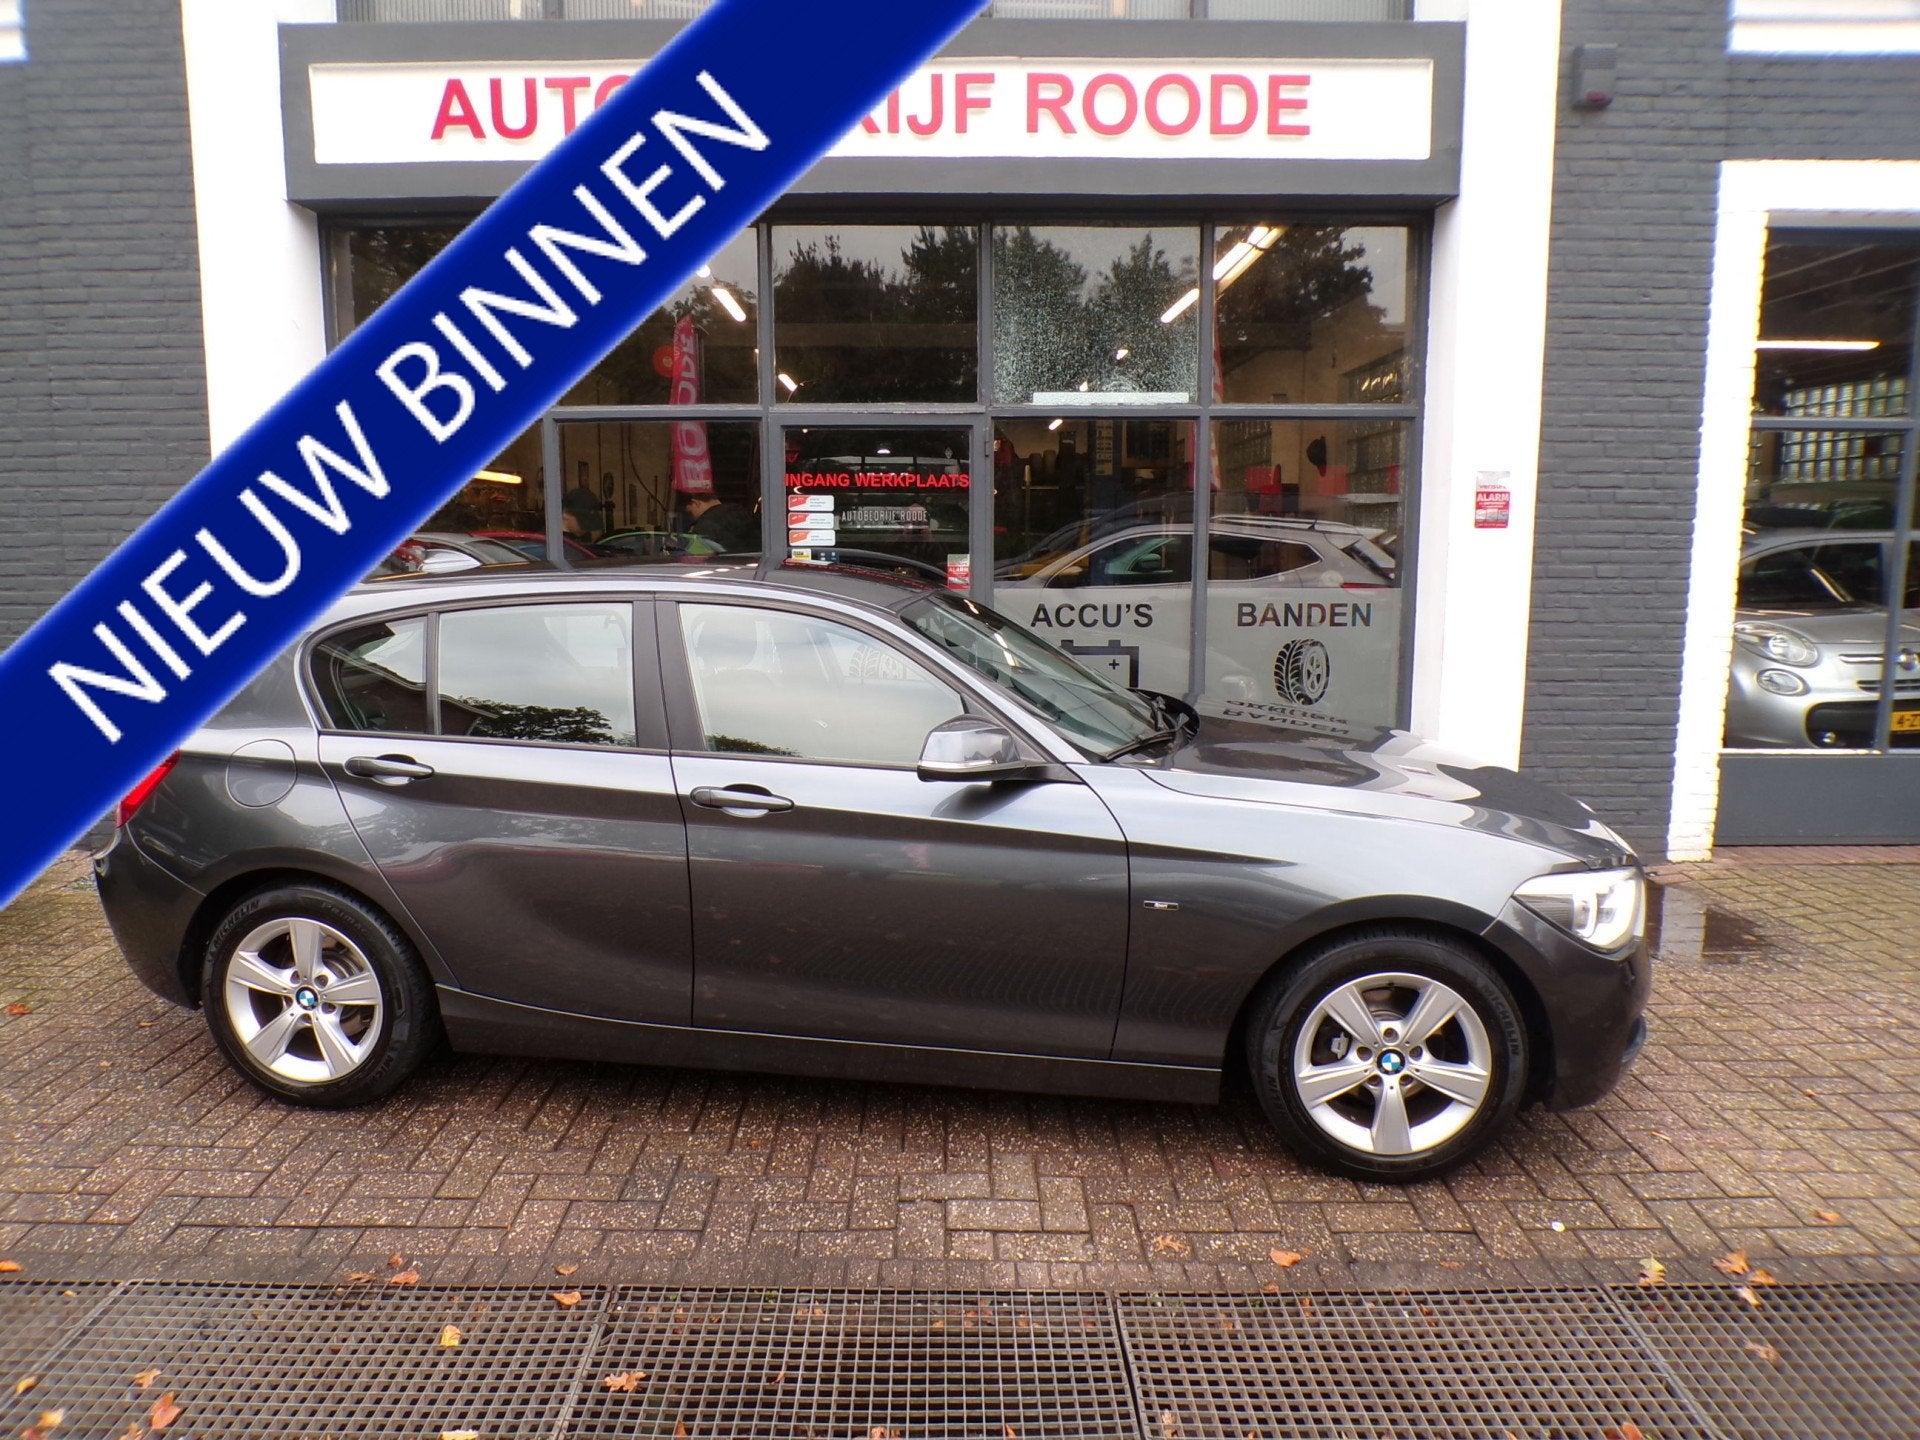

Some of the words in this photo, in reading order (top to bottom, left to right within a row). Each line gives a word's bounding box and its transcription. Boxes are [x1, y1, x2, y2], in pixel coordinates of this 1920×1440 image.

[1027, 73, 1311, 135] ROODE
[784, 473, 850, 487] INGANG
[855, 473, 970, 487] WERKPLAATS
[1477, 492, 1510, 502] ALARM
[1031, 603, 1153, 628] ACCU'S
[1237, 603, 1372, 628] BANDEN
